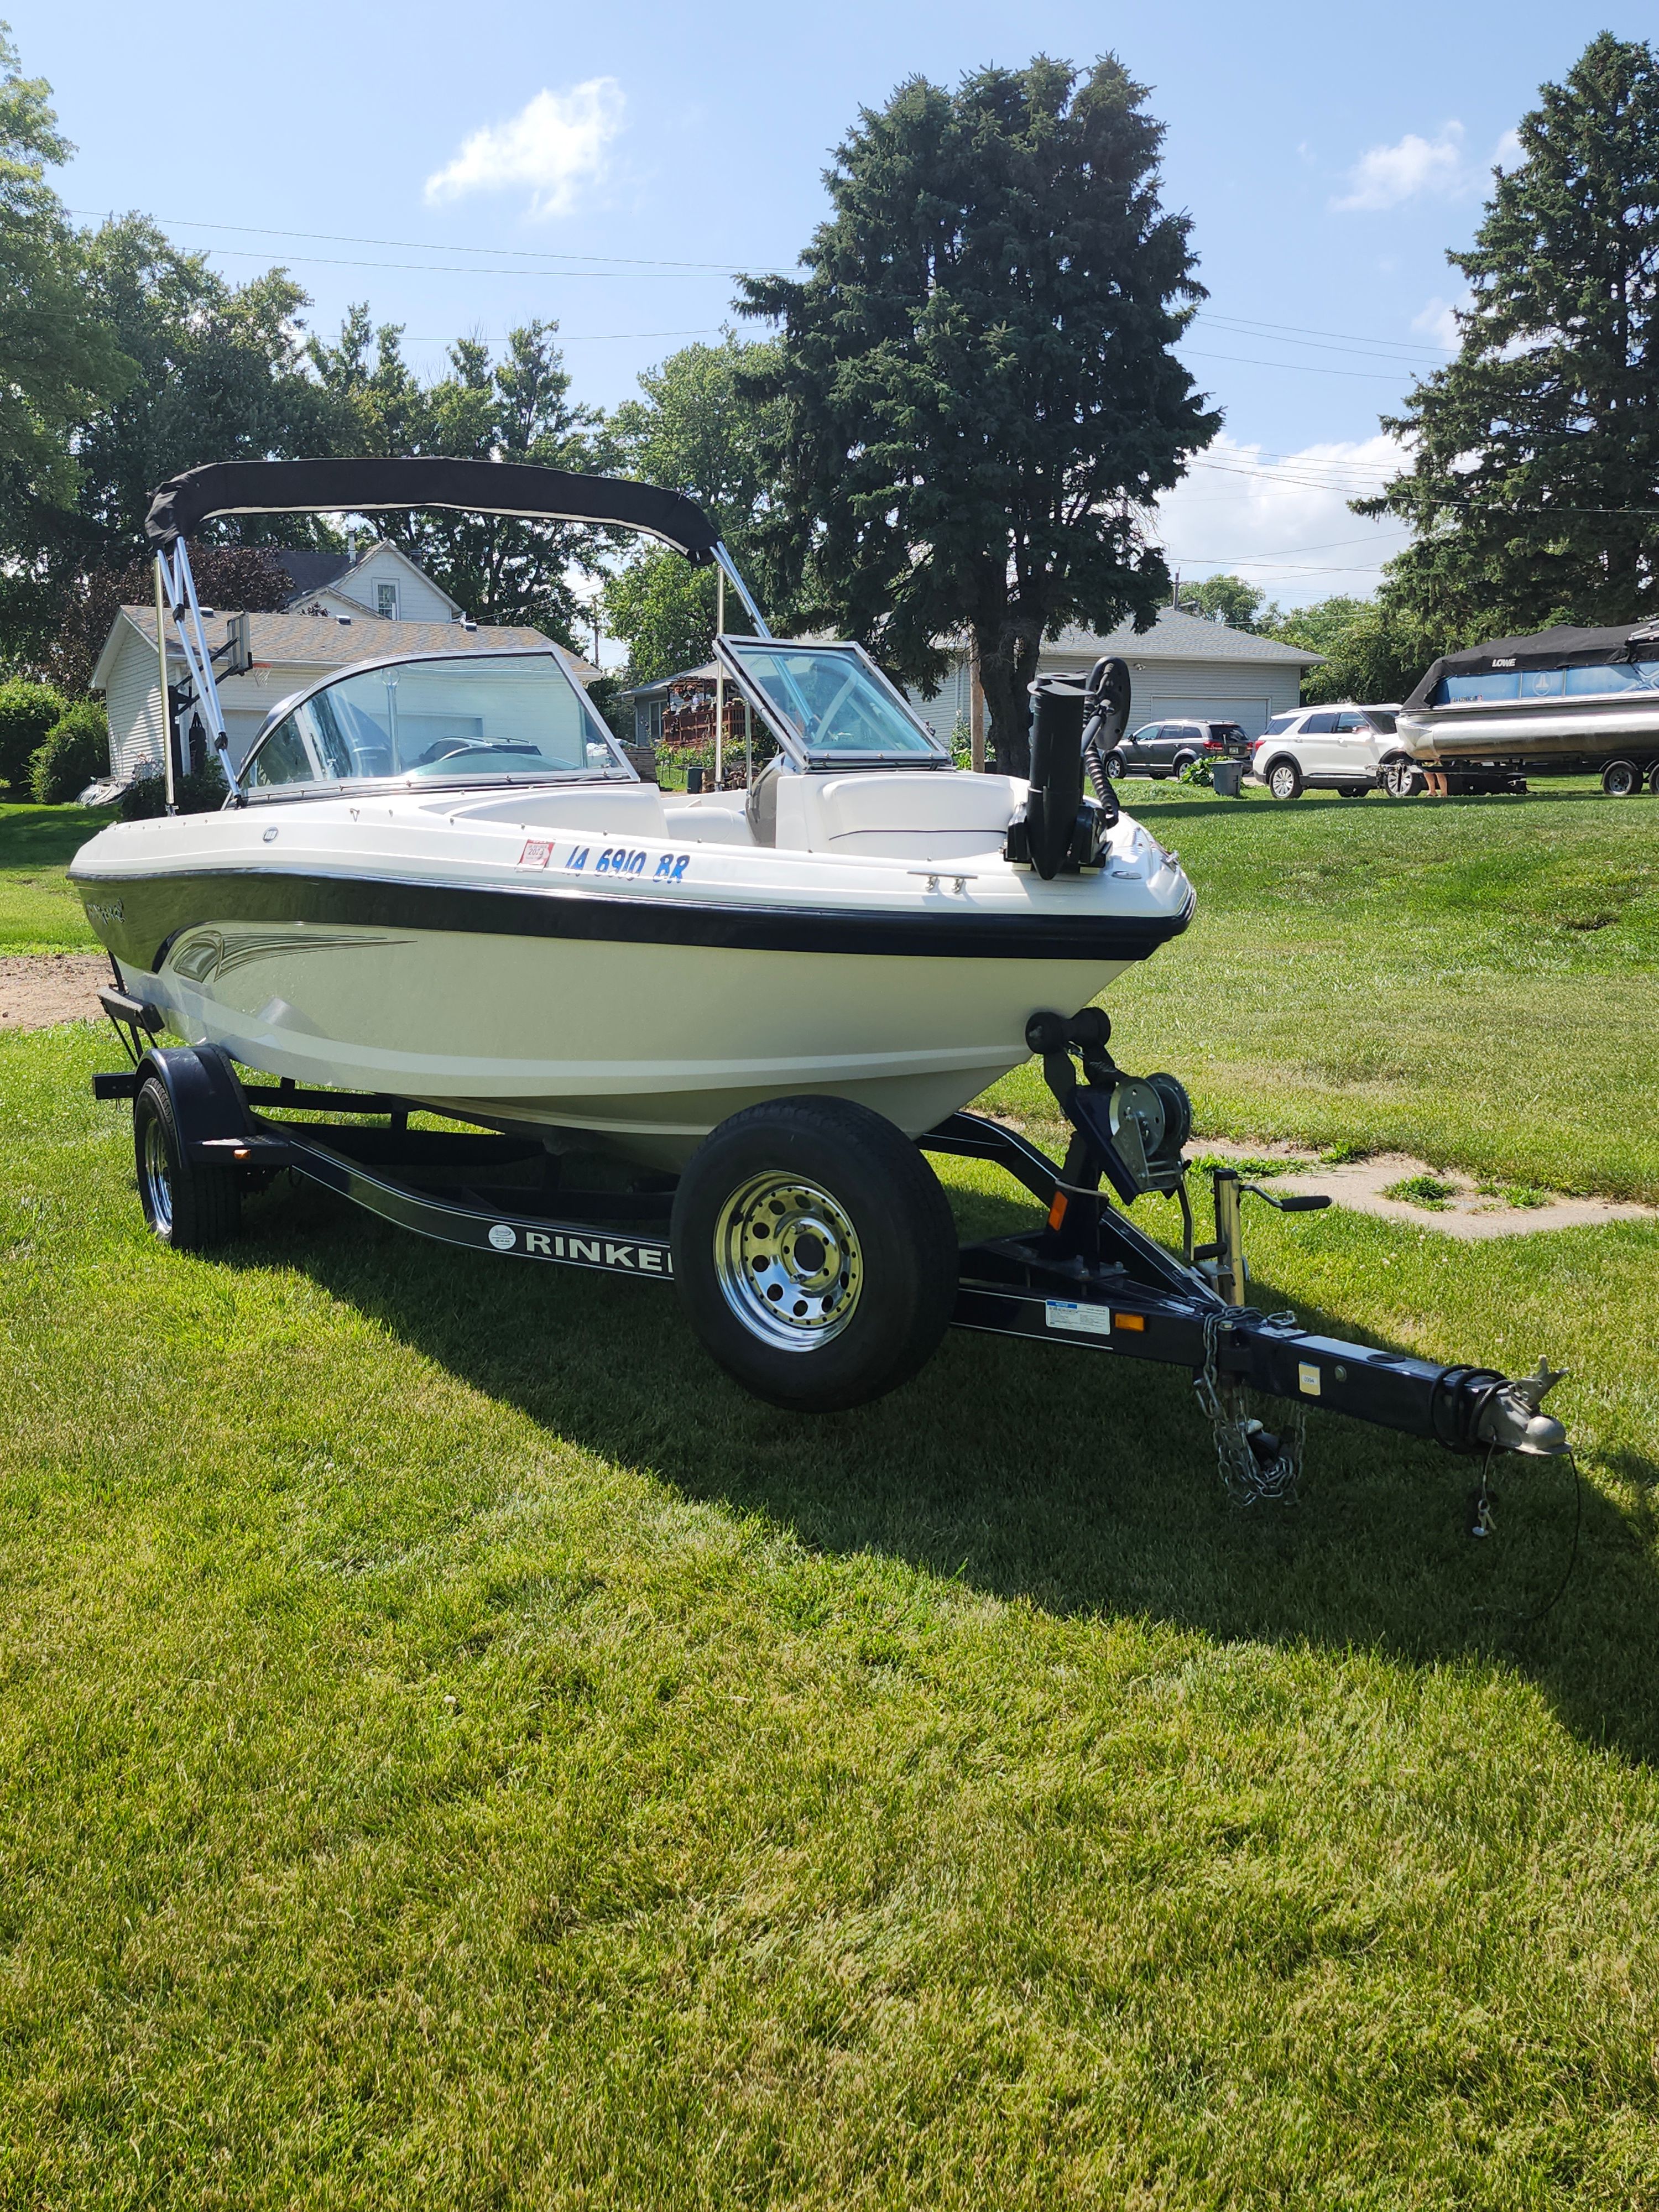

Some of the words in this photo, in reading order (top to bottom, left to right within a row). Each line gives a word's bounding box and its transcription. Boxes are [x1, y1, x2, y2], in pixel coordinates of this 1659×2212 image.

[1491, 658, 1516, 667] LOWE
[562, 845, 590, 877] IA
[594, 848, 647, 881] 6910
[526, 1232, 674, 1272] RINKE
